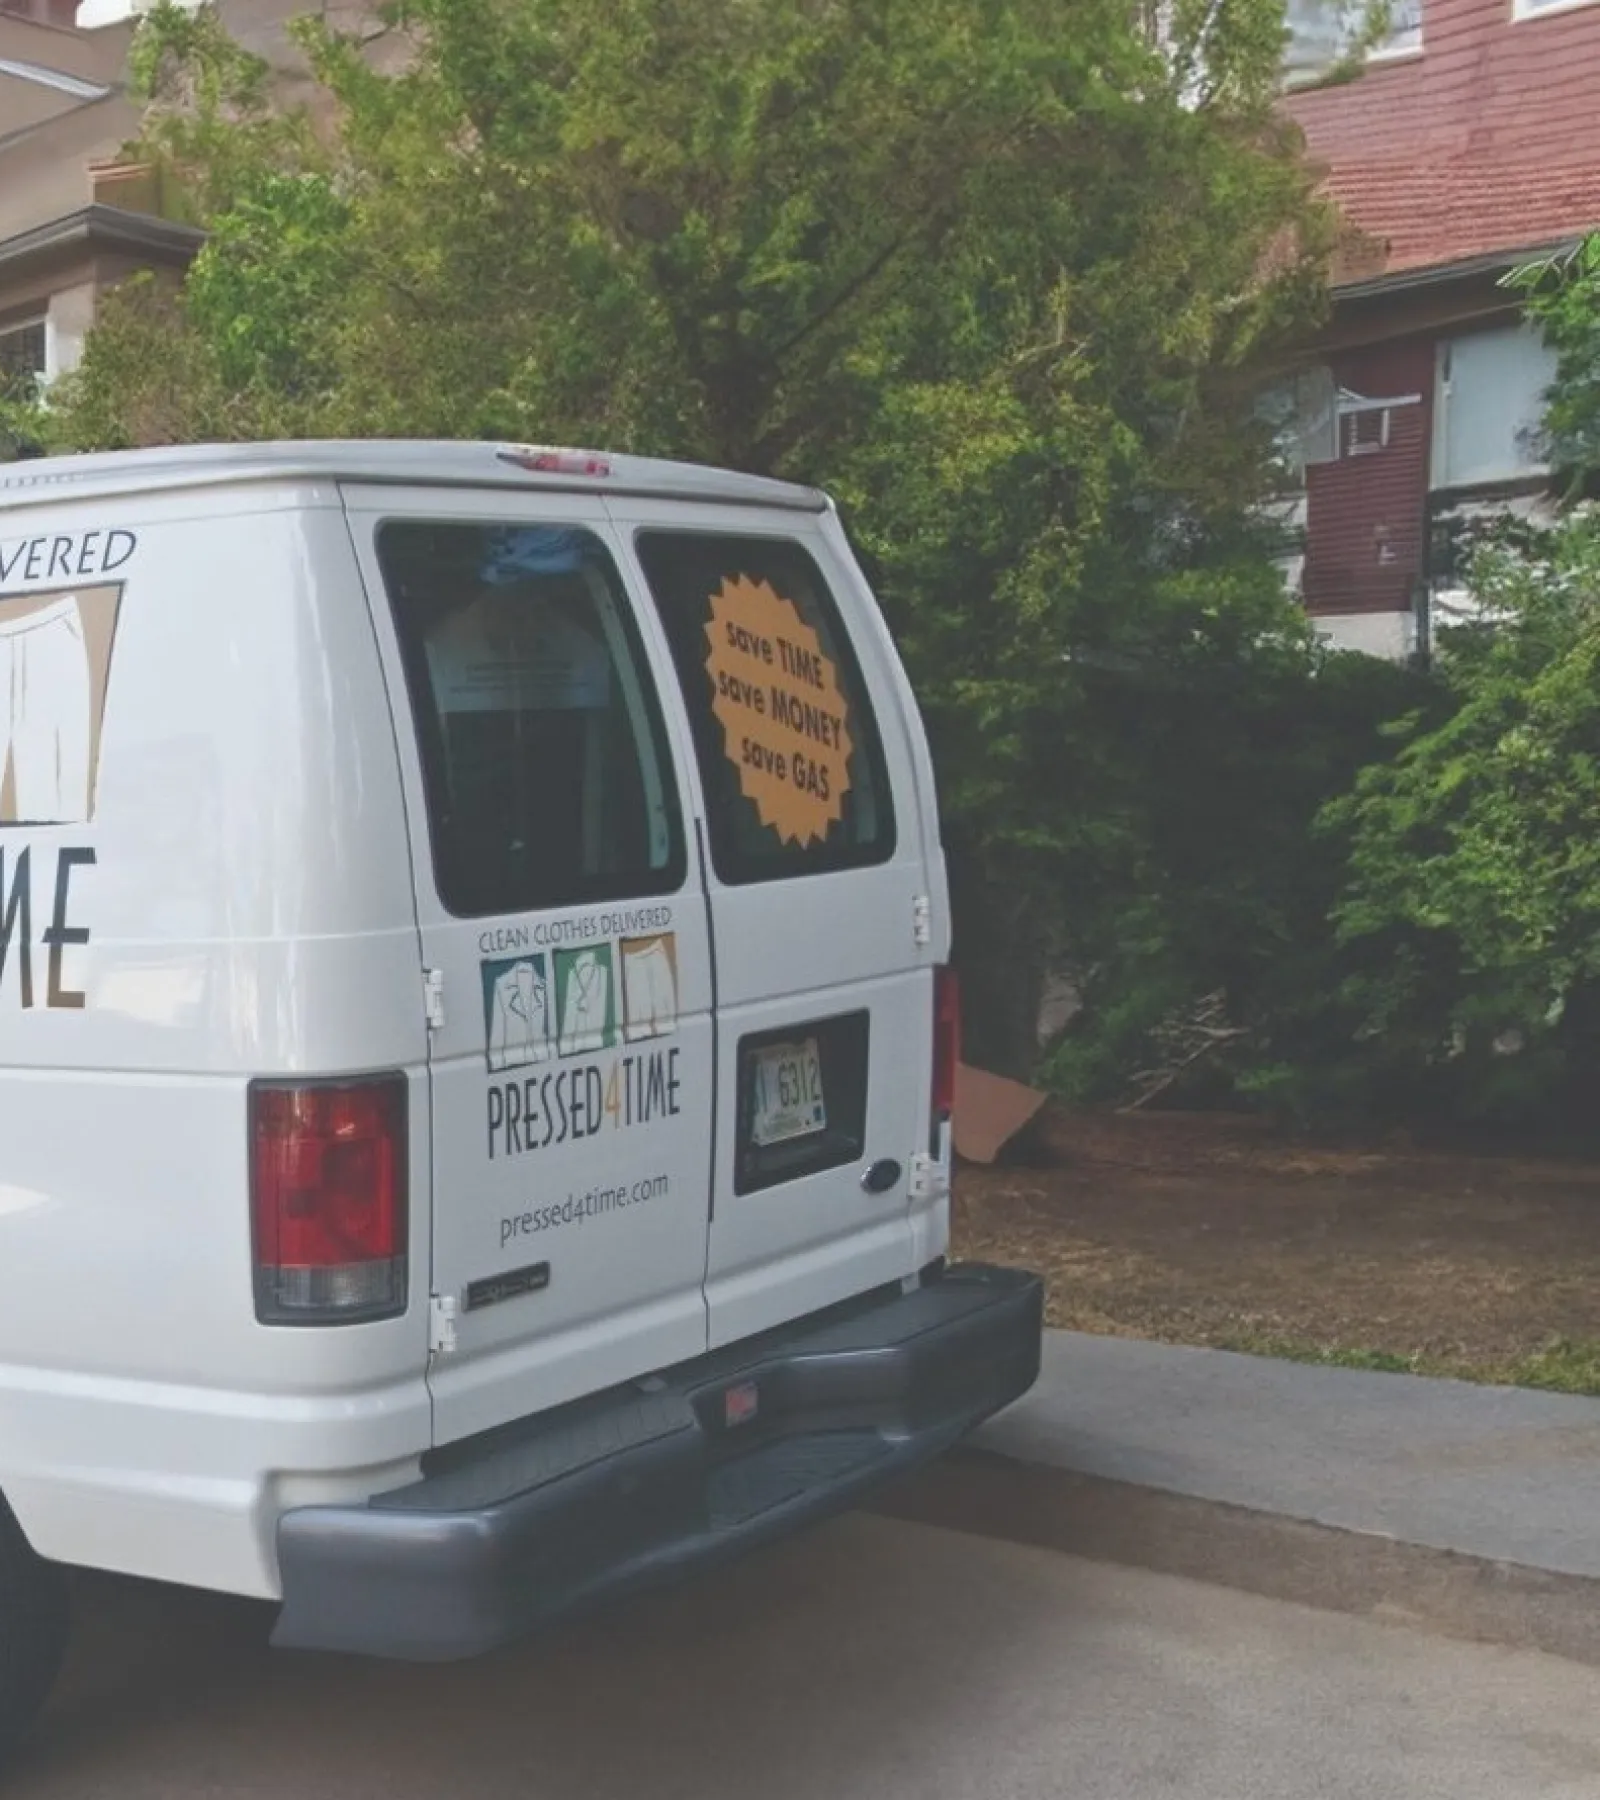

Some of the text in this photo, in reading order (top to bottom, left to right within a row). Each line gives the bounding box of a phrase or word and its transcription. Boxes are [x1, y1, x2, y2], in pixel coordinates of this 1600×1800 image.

[725, 620, 825, 690] save TIME
[717, 668, 842, 751] save MONEY
[741, 736, 830, 802] save GAS
[478, 905, 673, 954] CLEAN CLOTHES DELIVERED
[500, 1174, 669, 1249] pressed4time.com
